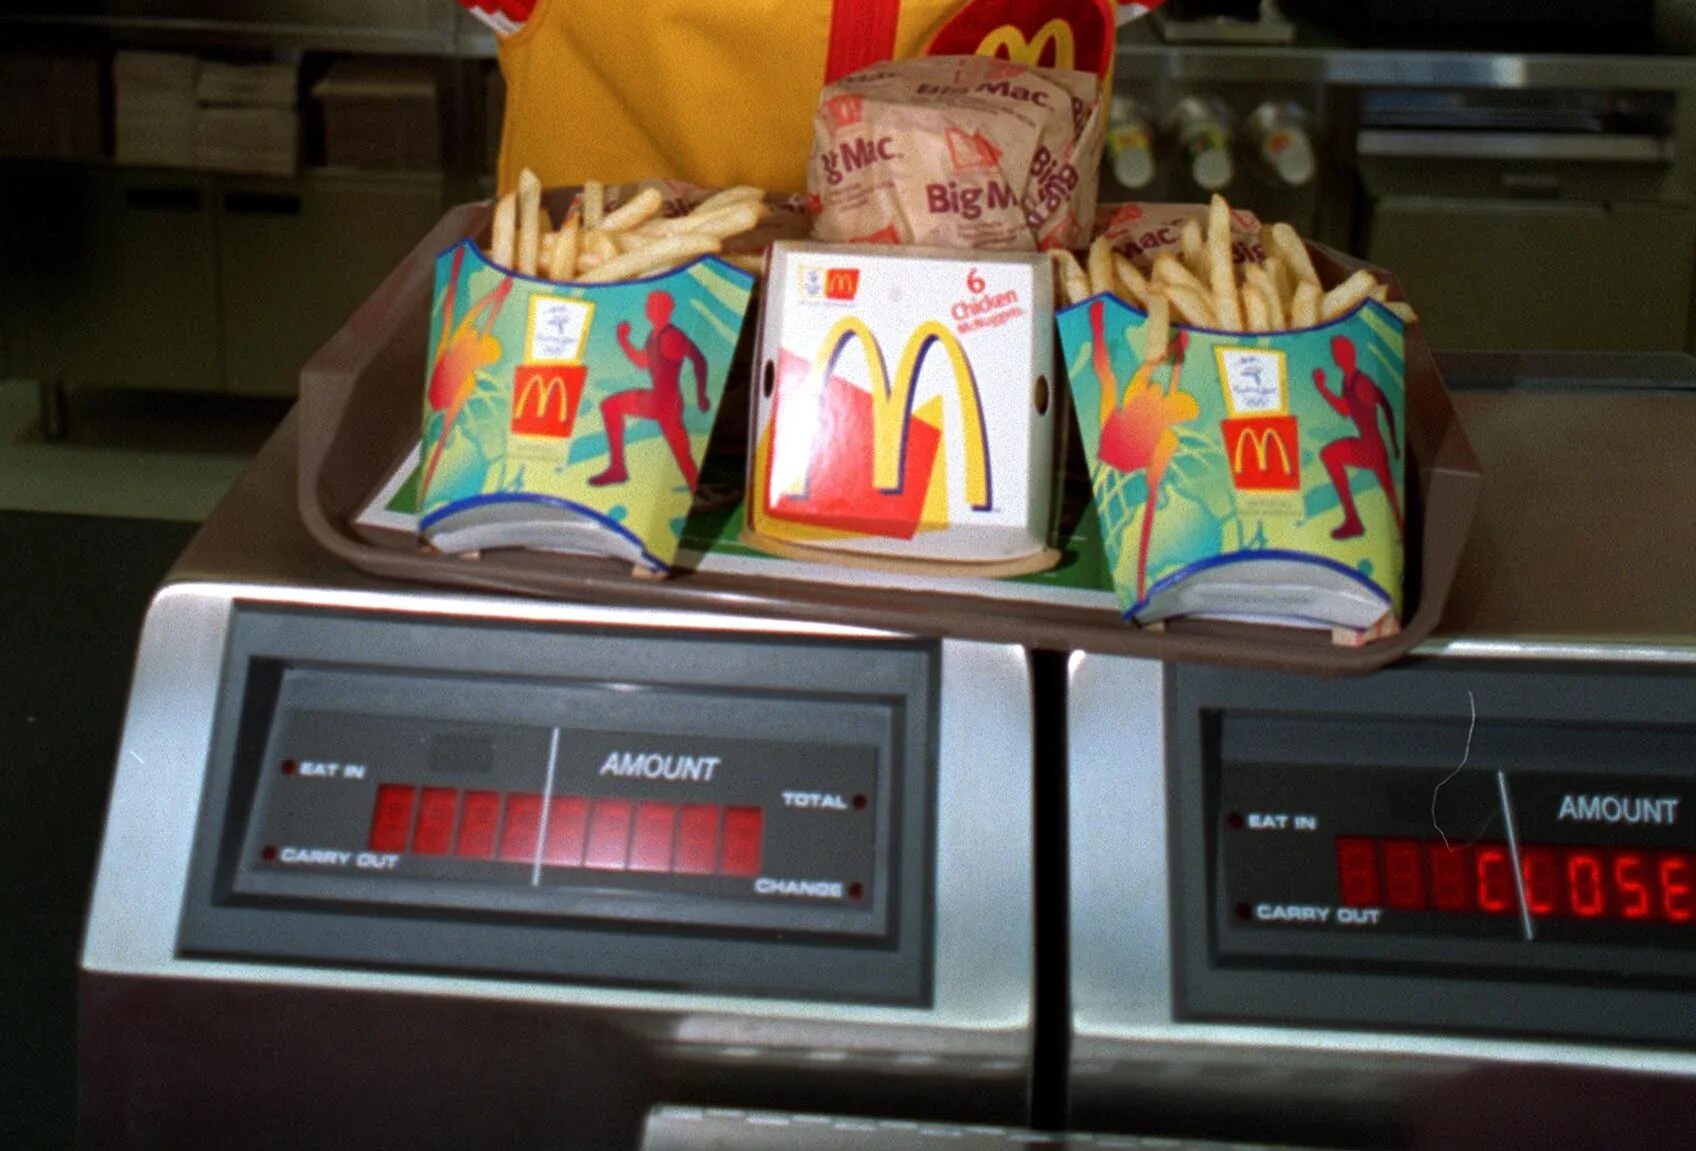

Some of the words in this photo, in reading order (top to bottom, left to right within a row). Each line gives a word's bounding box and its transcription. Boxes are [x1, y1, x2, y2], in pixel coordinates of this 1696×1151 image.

[926, 180, 983, 220] Big
[966, 267, 986, 294] 6
[951, 290, 1019, 322] Chicken
[299, 760, 339, 777] EAT
[343, 764, 367, 780] IN
[599, 751, 721, 781] AMOUNT
[782, 790, 848, 810] TOTAL
[1557, 795, 1680, 825] AMOUNT
[1247, 813, 1289, 829] EAT
[1293, 815, 1318, 830] IN
[279, 846, 352, 866] CARRY
[356, 852, 400, 870] OUT
[755, 877, 844, 899] CHANGE
[1256, 903, 1331, 922] CARRY
[1336, 908, 1381, 924] OUT
